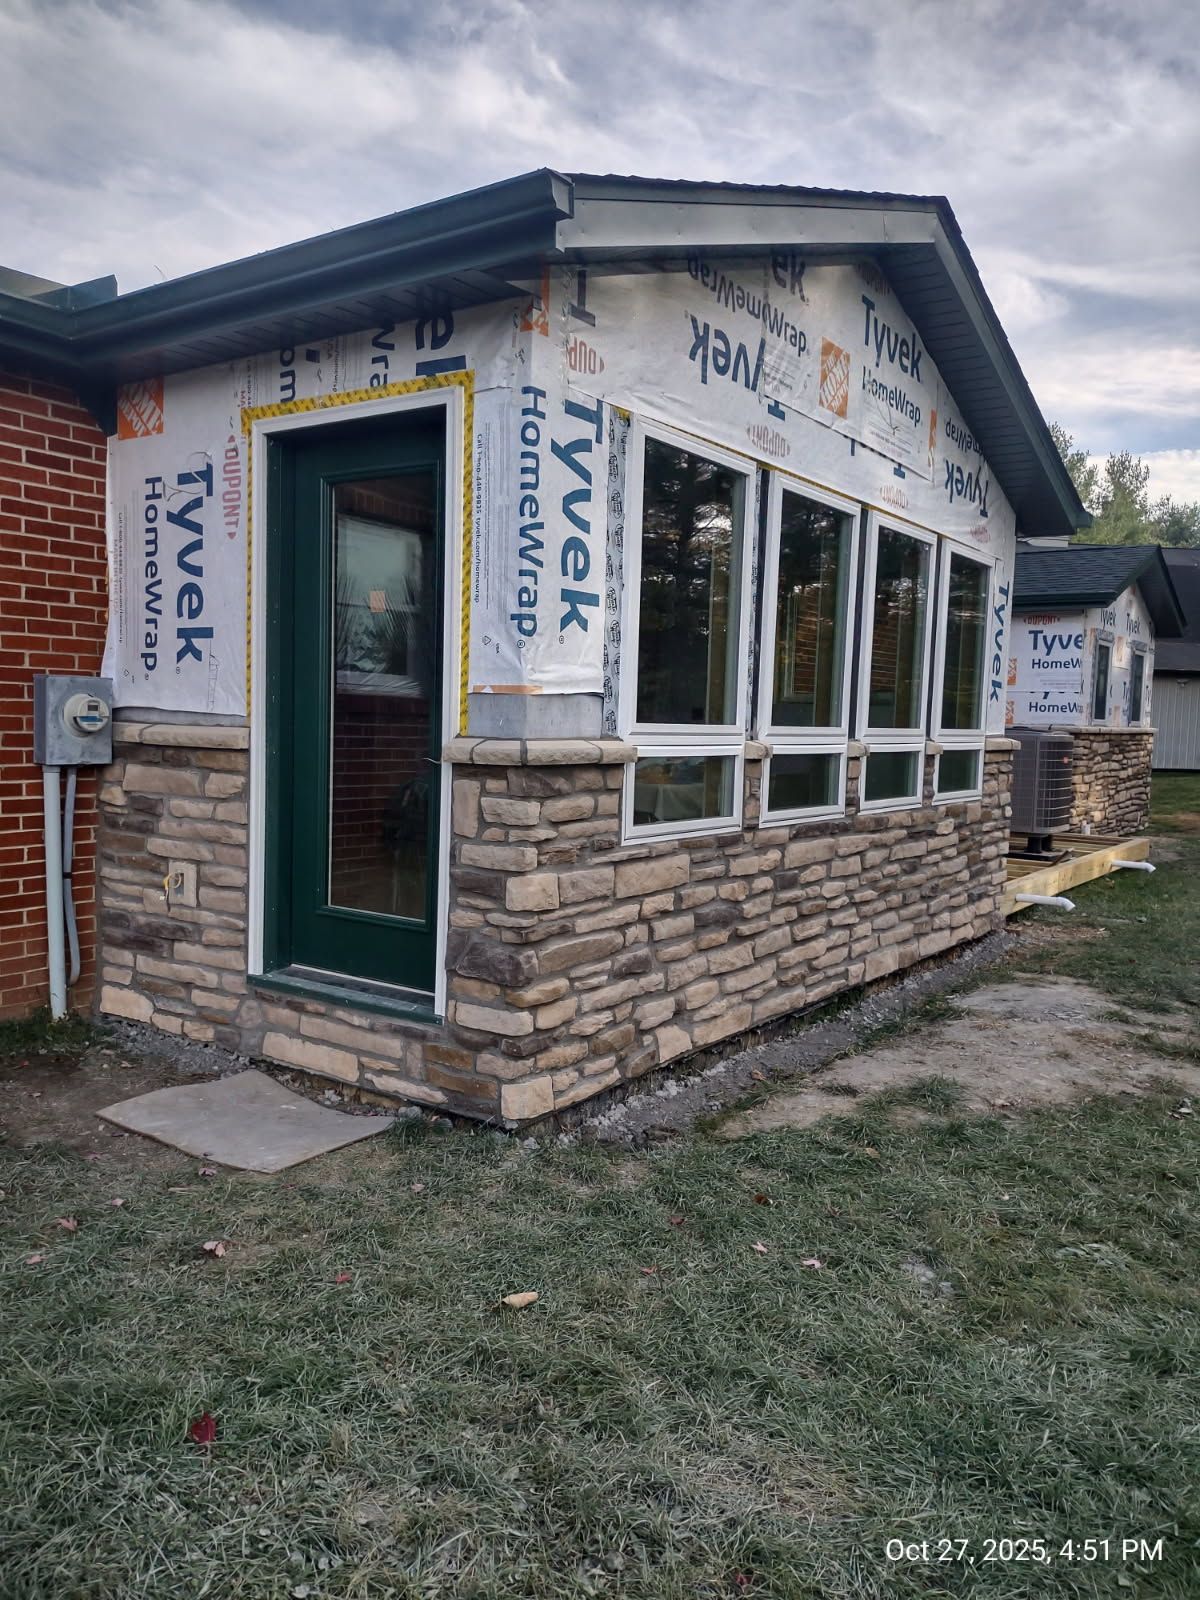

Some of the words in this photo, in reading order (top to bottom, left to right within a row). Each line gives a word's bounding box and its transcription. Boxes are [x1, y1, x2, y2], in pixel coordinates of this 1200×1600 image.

[862, 294, 922, 383] Tyvek
[861, 365, 921, 427] HomeWrap
[222, 443, 241, 528] DUPONT
[510, 385, 547, 638] HomeWrap
[551, 399, 604, 633] Tyvek
[944, 459, 988, 518] Tyvek
[141, 475, 163, 672] HomeWrap
[166, 461, 214, 664] Tyvek
[990, 581, 1010, 702] Tyvek
[1027, 615, 1057, 625] DUPONT
